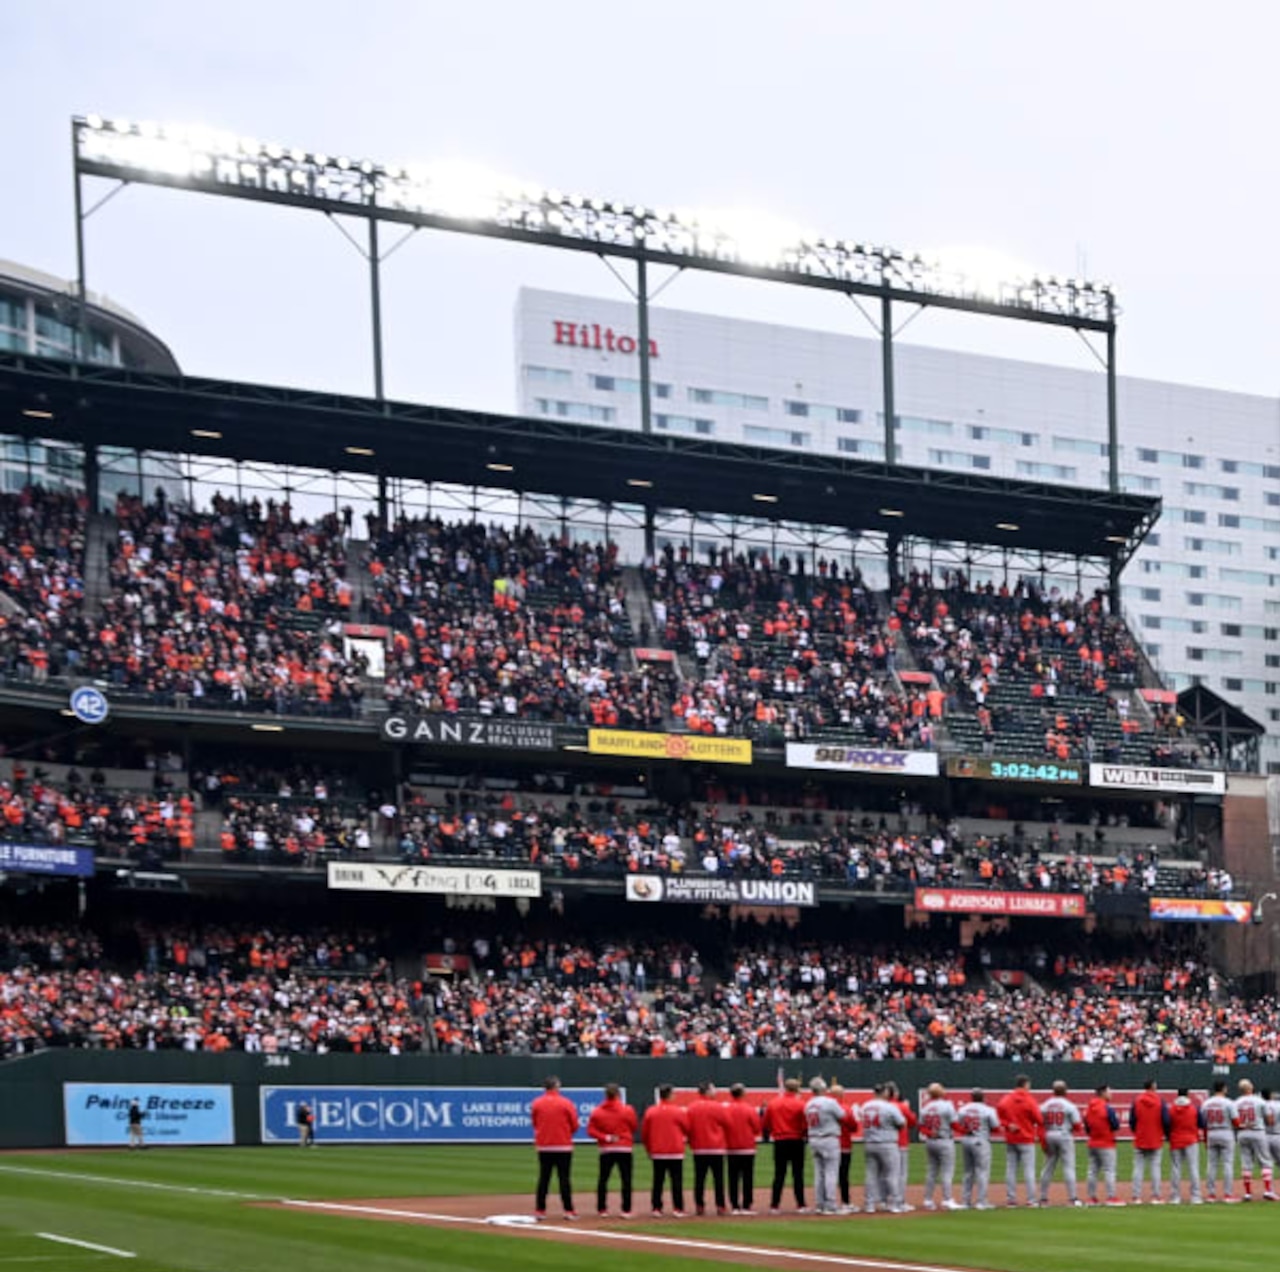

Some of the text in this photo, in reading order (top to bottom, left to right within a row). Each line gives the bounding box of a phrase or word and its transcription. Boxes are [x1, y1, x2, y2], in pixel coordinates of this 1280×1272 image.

[76, 696, 101, 714] 42
[385, 718, 485, 743] GANZ
[597, 736, 742, 756] MARYLAND LOTTERY
[991, 762, 1058, 780] 3:02:42
[1104, 768, 1158, 785] WBAL
[14, 846, 77, 865] FURNITURE
[666, 888, 692, 898] PIPE
[740, 880, 814, 904] UNION
[950, 895, 1005, 908] JOHNSON
[147, 1096, 216, 1110] Breeze
[462, 1103, 493, 1113] LAKE
[496, 1103, 521, 1113] ERIE
[462, 1115, 533, 1127] OSTEOPATH
